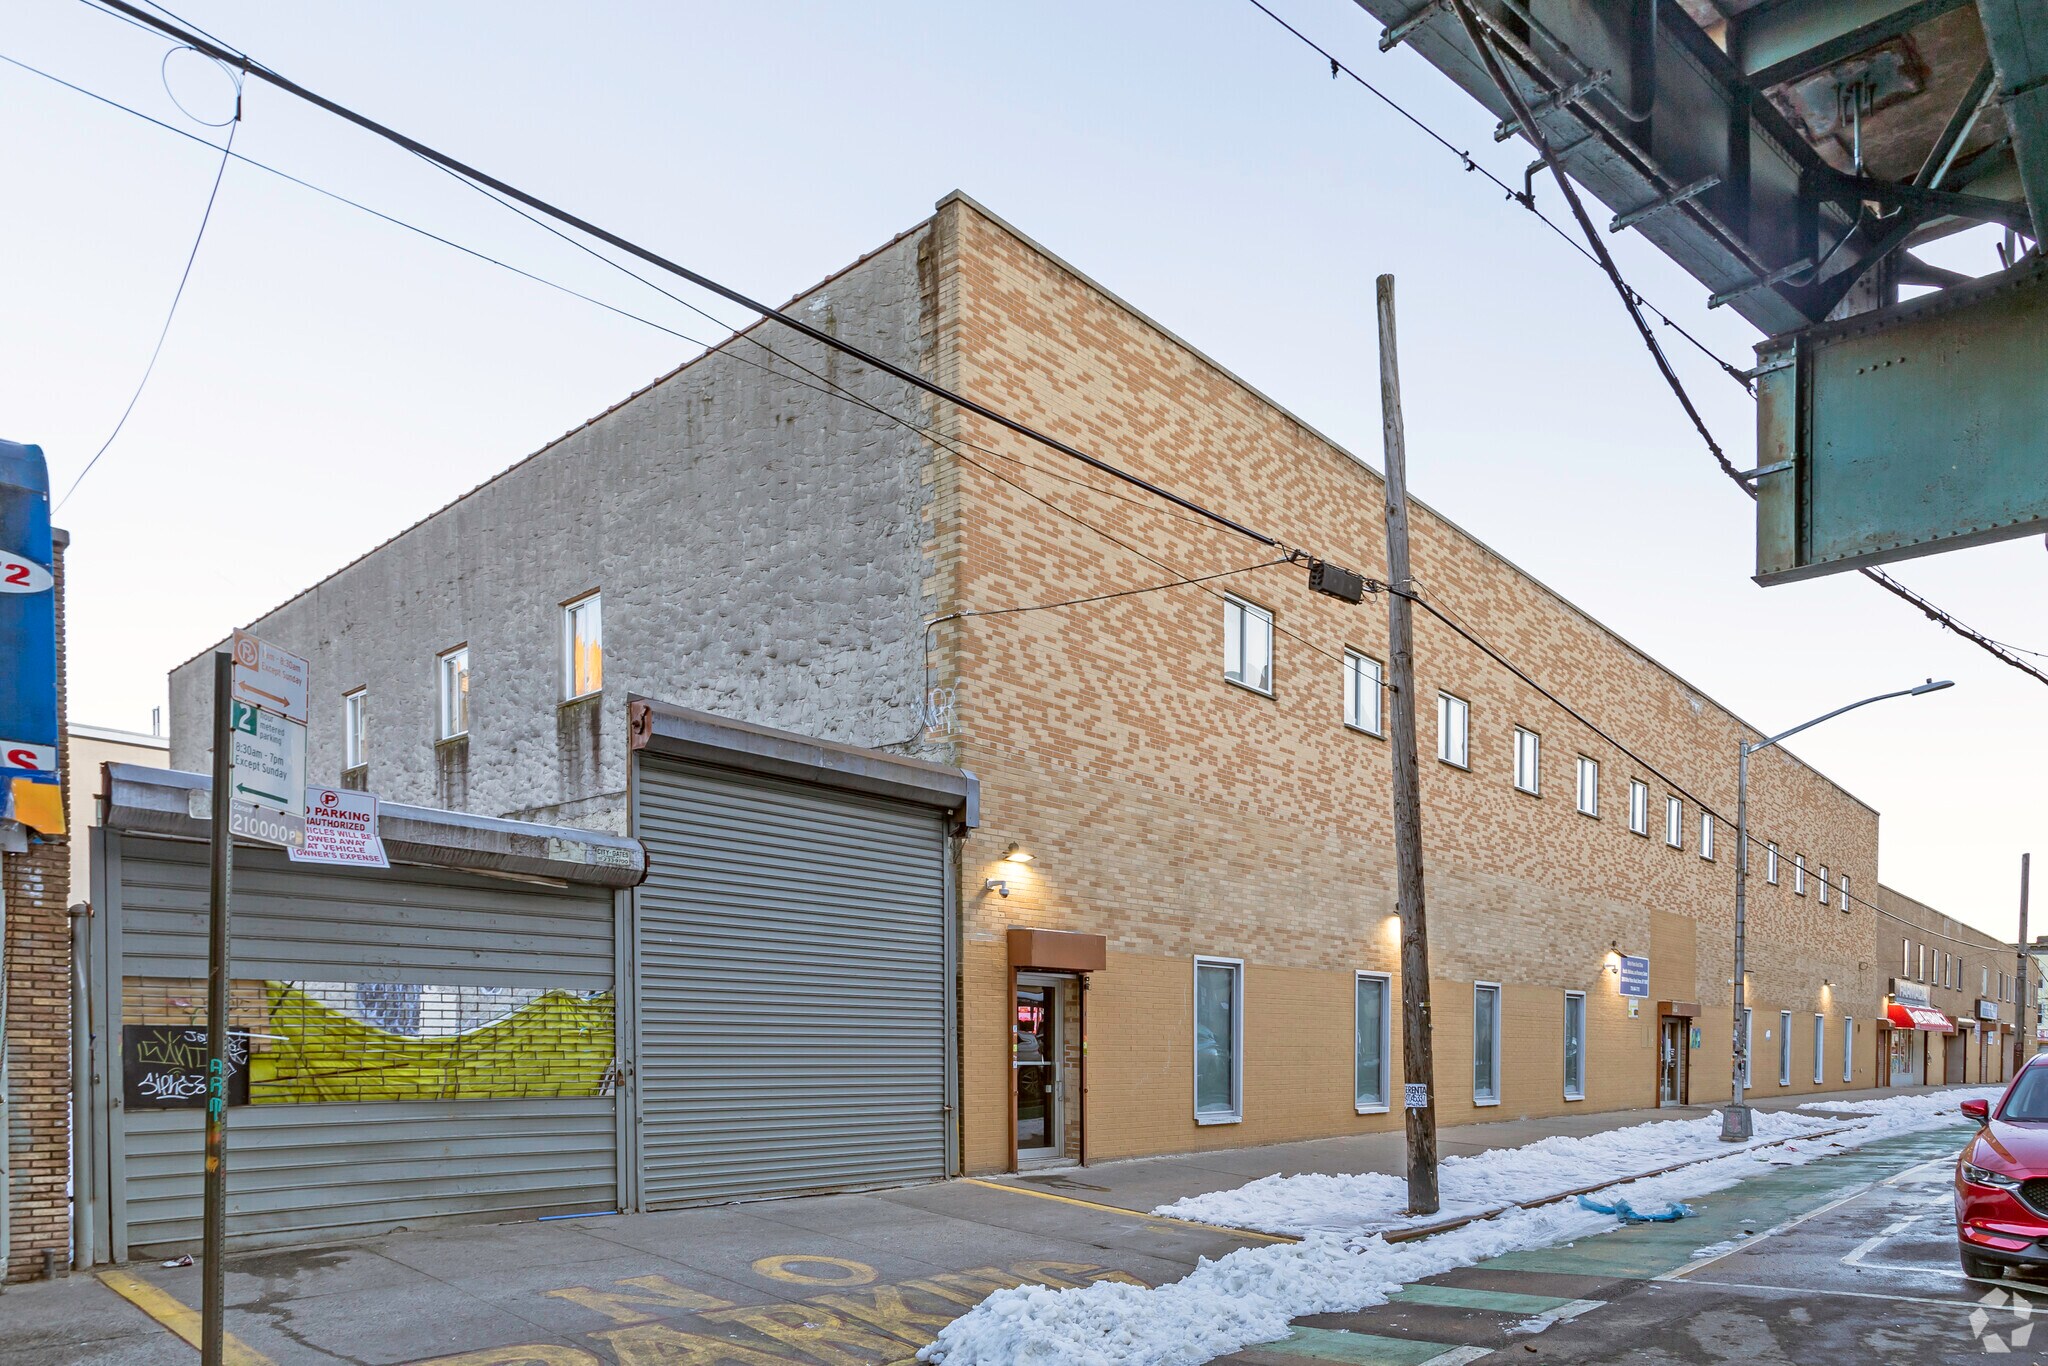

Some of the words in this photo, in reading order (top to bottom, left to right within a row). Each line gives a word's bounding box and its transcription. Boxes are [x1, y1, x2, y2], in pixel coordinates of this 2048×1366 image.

[261, 661, 281, 677] Except
[282, 670, 303, 687] Sunday
[238, 703, 252, 730] 2
[260, 722, 285, 736] metered
[260, 732, 282, 746] parking
[235, 741, 263, 759] 8:30am
[270, 752, 284, 766] 7pm
[235, 754, 261, 771] Except
[262, 763, 288, 781] Sunday
[315, 807, 370, 822] PARKING
[233, 813, 288, 842] 210000
[307, 835, 337, 844] OWED
[339, 838, 366, 846] AWAY
[337, 830, 358, 839] WILL
[360, 833, 373, 841] BE
[296, 849, 337, 859] OWNER'S
[339, 852, 380, 862] EXPENSE
[321, 843, 366, 854] VEHICLE
[538, 1255, 879, 1323] NO
